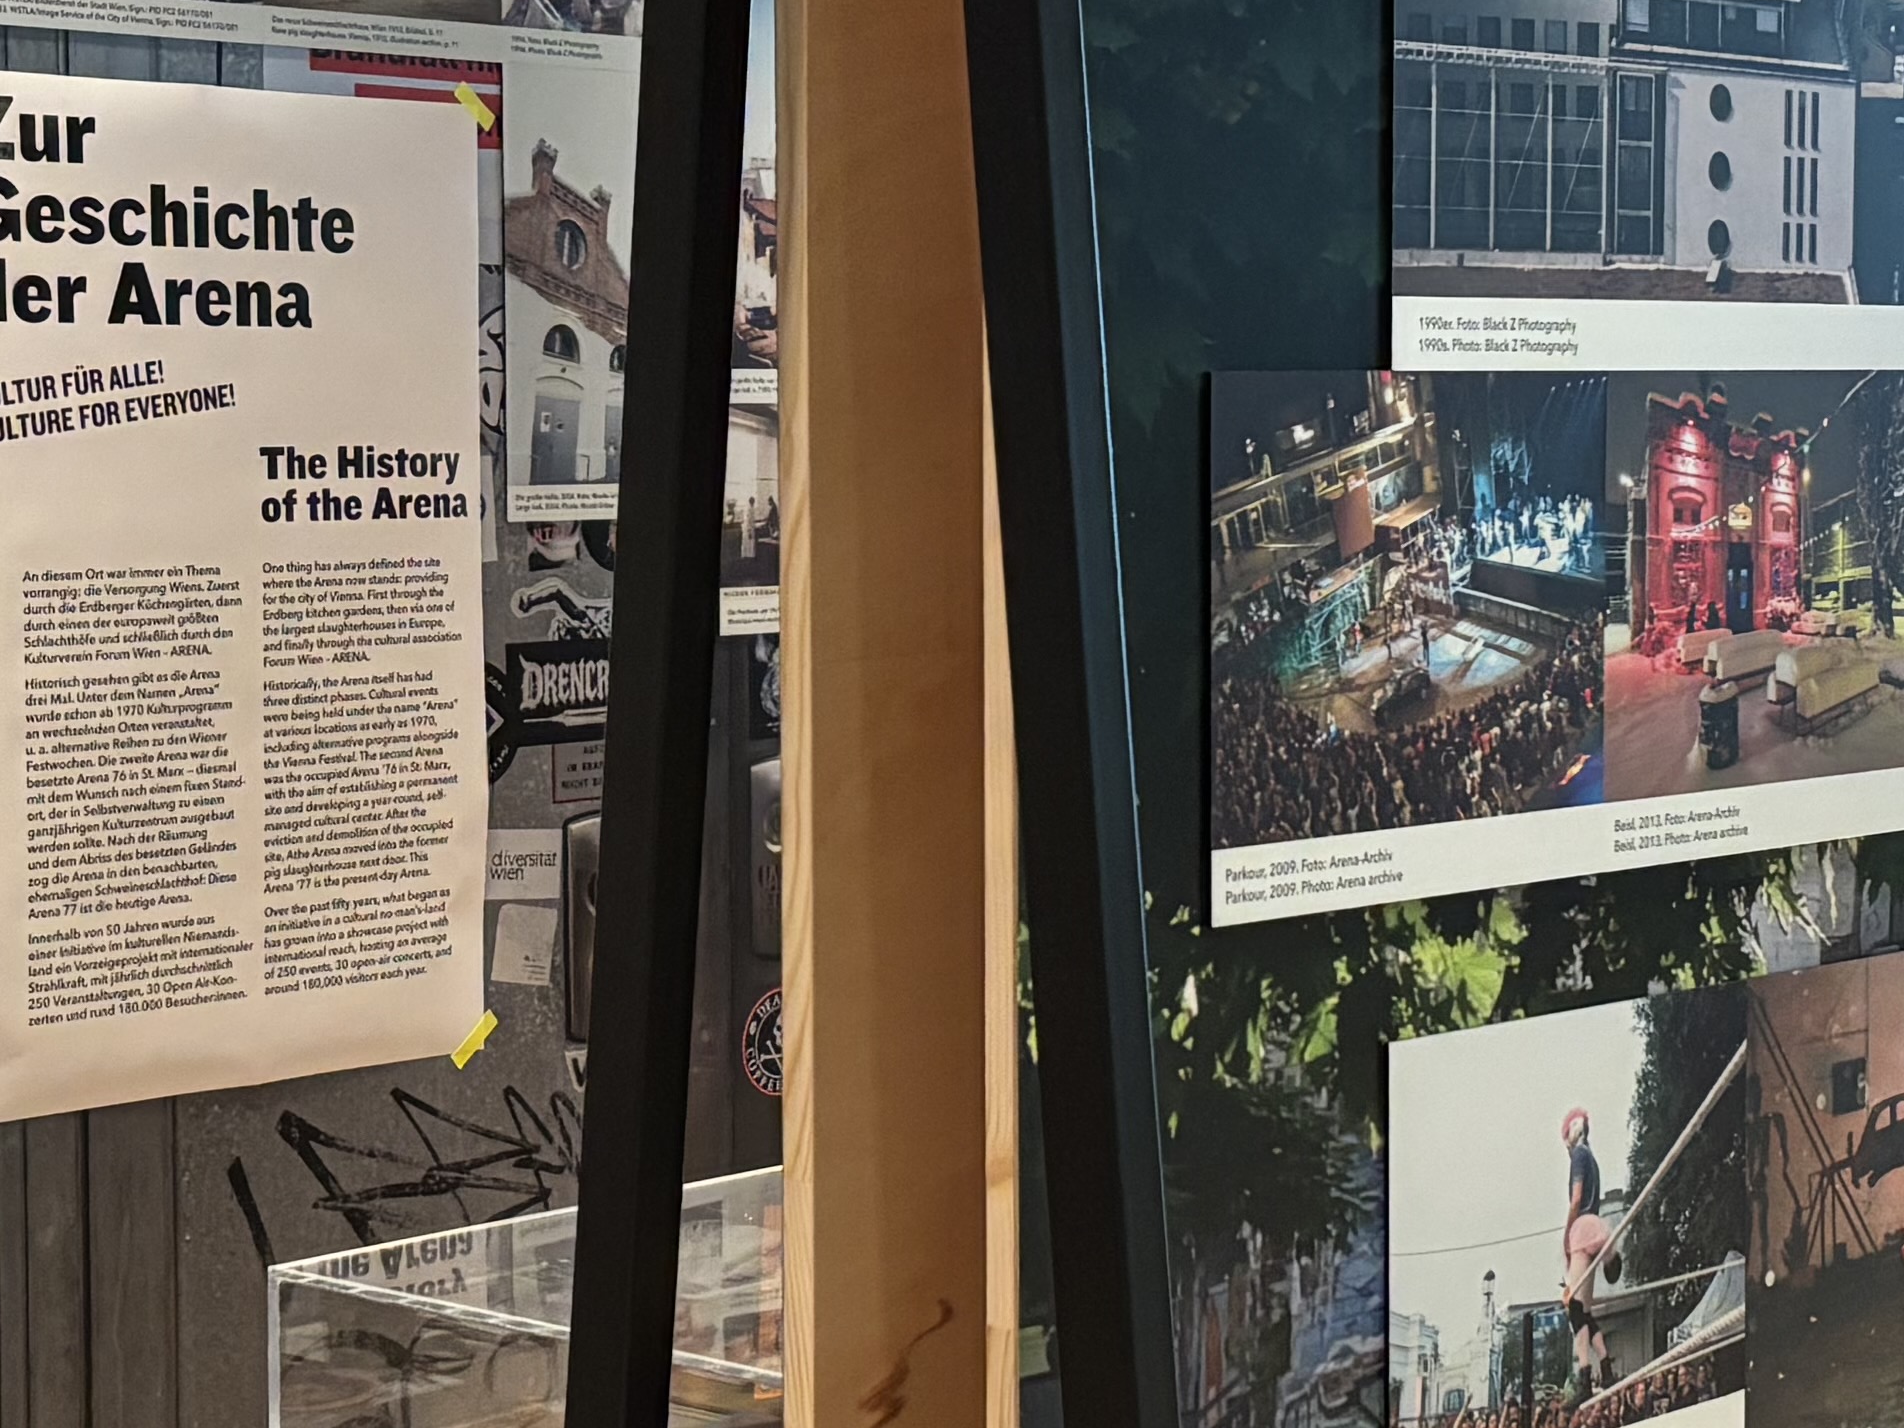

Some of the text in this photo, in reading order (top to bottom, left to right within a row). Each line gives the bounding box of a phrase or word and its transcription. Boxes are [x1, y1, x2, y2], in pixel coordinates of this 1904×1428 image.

[107, 261, 313, 329] Arena
[61, 364, 105, 398] FÜR
[109, 359, 165, 391] ALLE!
[78, 400, 122, 430] FOR
[124, 382, 236, 423] EVERYONE!
[258, 445, 460, 486] The History
[261, 486, 468, 523] of the Arena
[491, 849, 558, 868] diversität
[1269, 859, 1300, 878] 2009.
